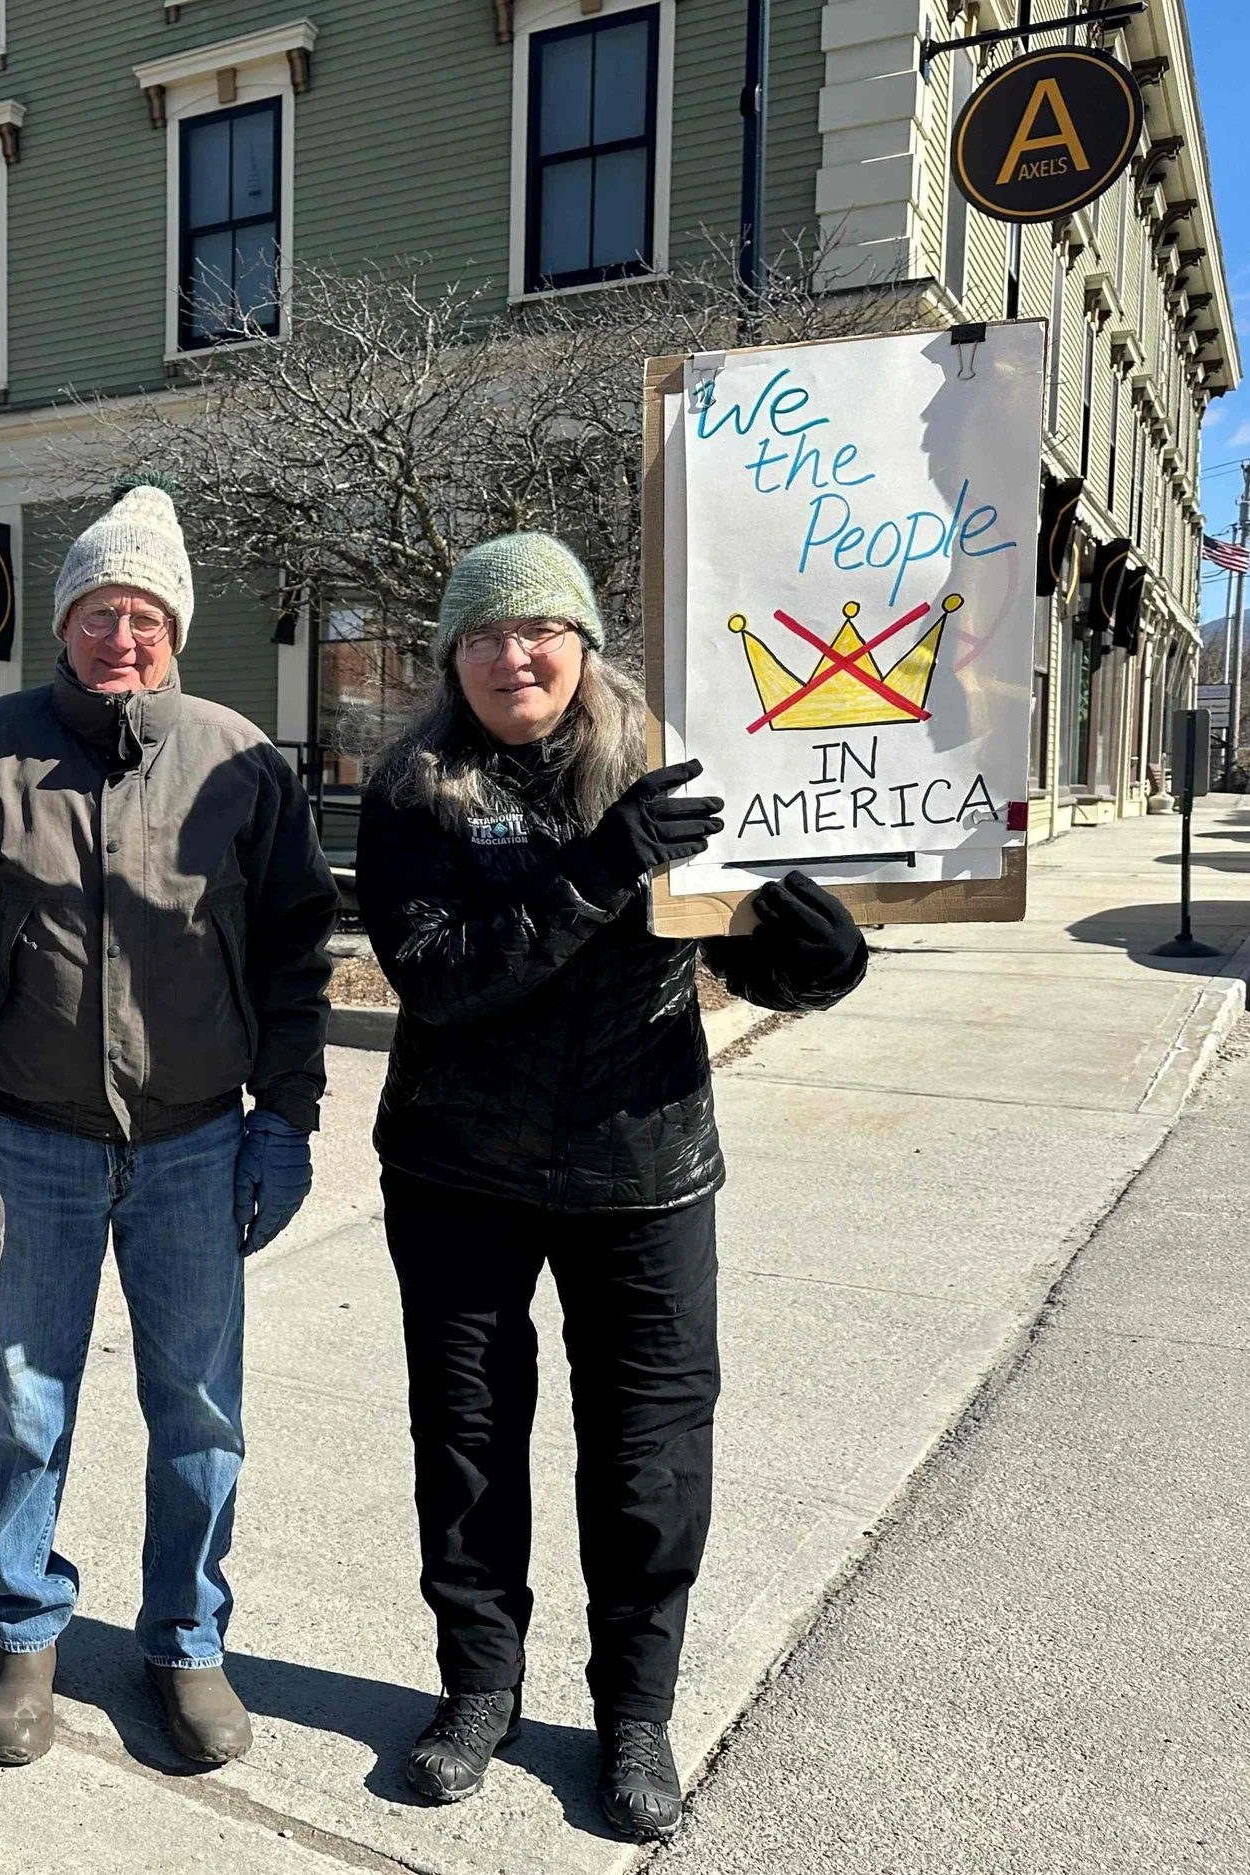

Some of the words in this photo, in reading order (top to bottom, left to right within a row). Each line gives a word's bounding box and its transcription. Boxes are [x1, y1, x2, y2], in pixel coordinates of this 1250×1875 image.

[996, 78, 1090, 185] A
[692, 368, 830, 439] We
[745, 432, 876, 493] the
[798, 479, 1017, 607] People
[809, 736, 877, 784] IN
[467, 814, 524, 825] CATAMOUNT
[468, 821, 527, 838] TRIL
[737, 774, 999, 838] AMERICA
[471, 836, 528, 845] ASSOCIATION
